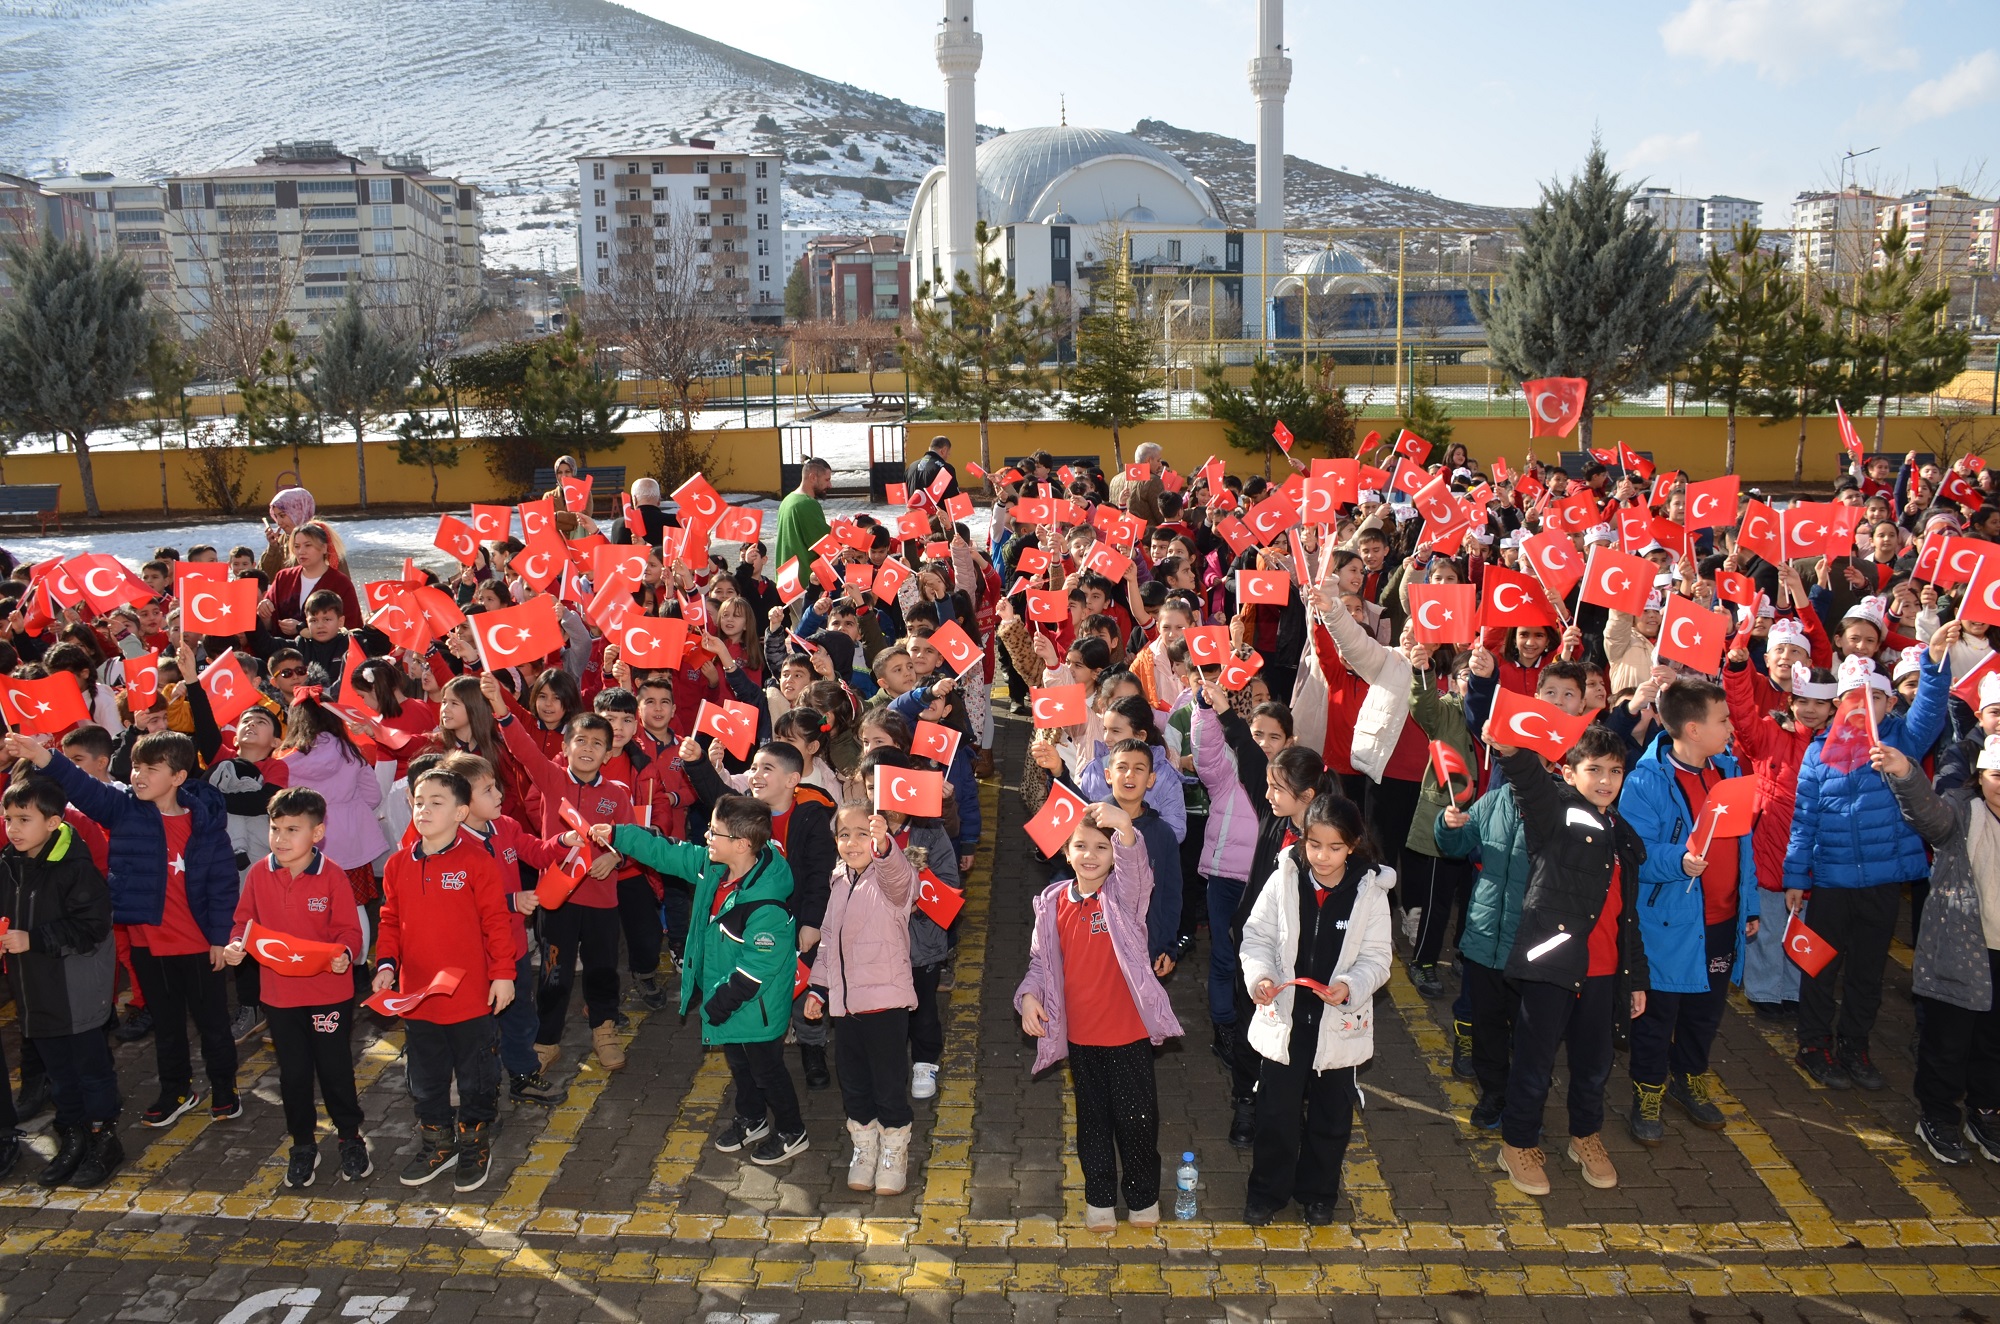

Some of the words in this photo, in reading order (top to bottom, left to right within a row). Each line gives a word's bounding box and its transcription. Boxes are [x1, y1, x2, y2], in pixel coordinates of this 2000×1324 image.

[441, 871, 467, 890] EG
[308, 897, 328, 912] EG
[312, 1011, 340, 1034] EG
